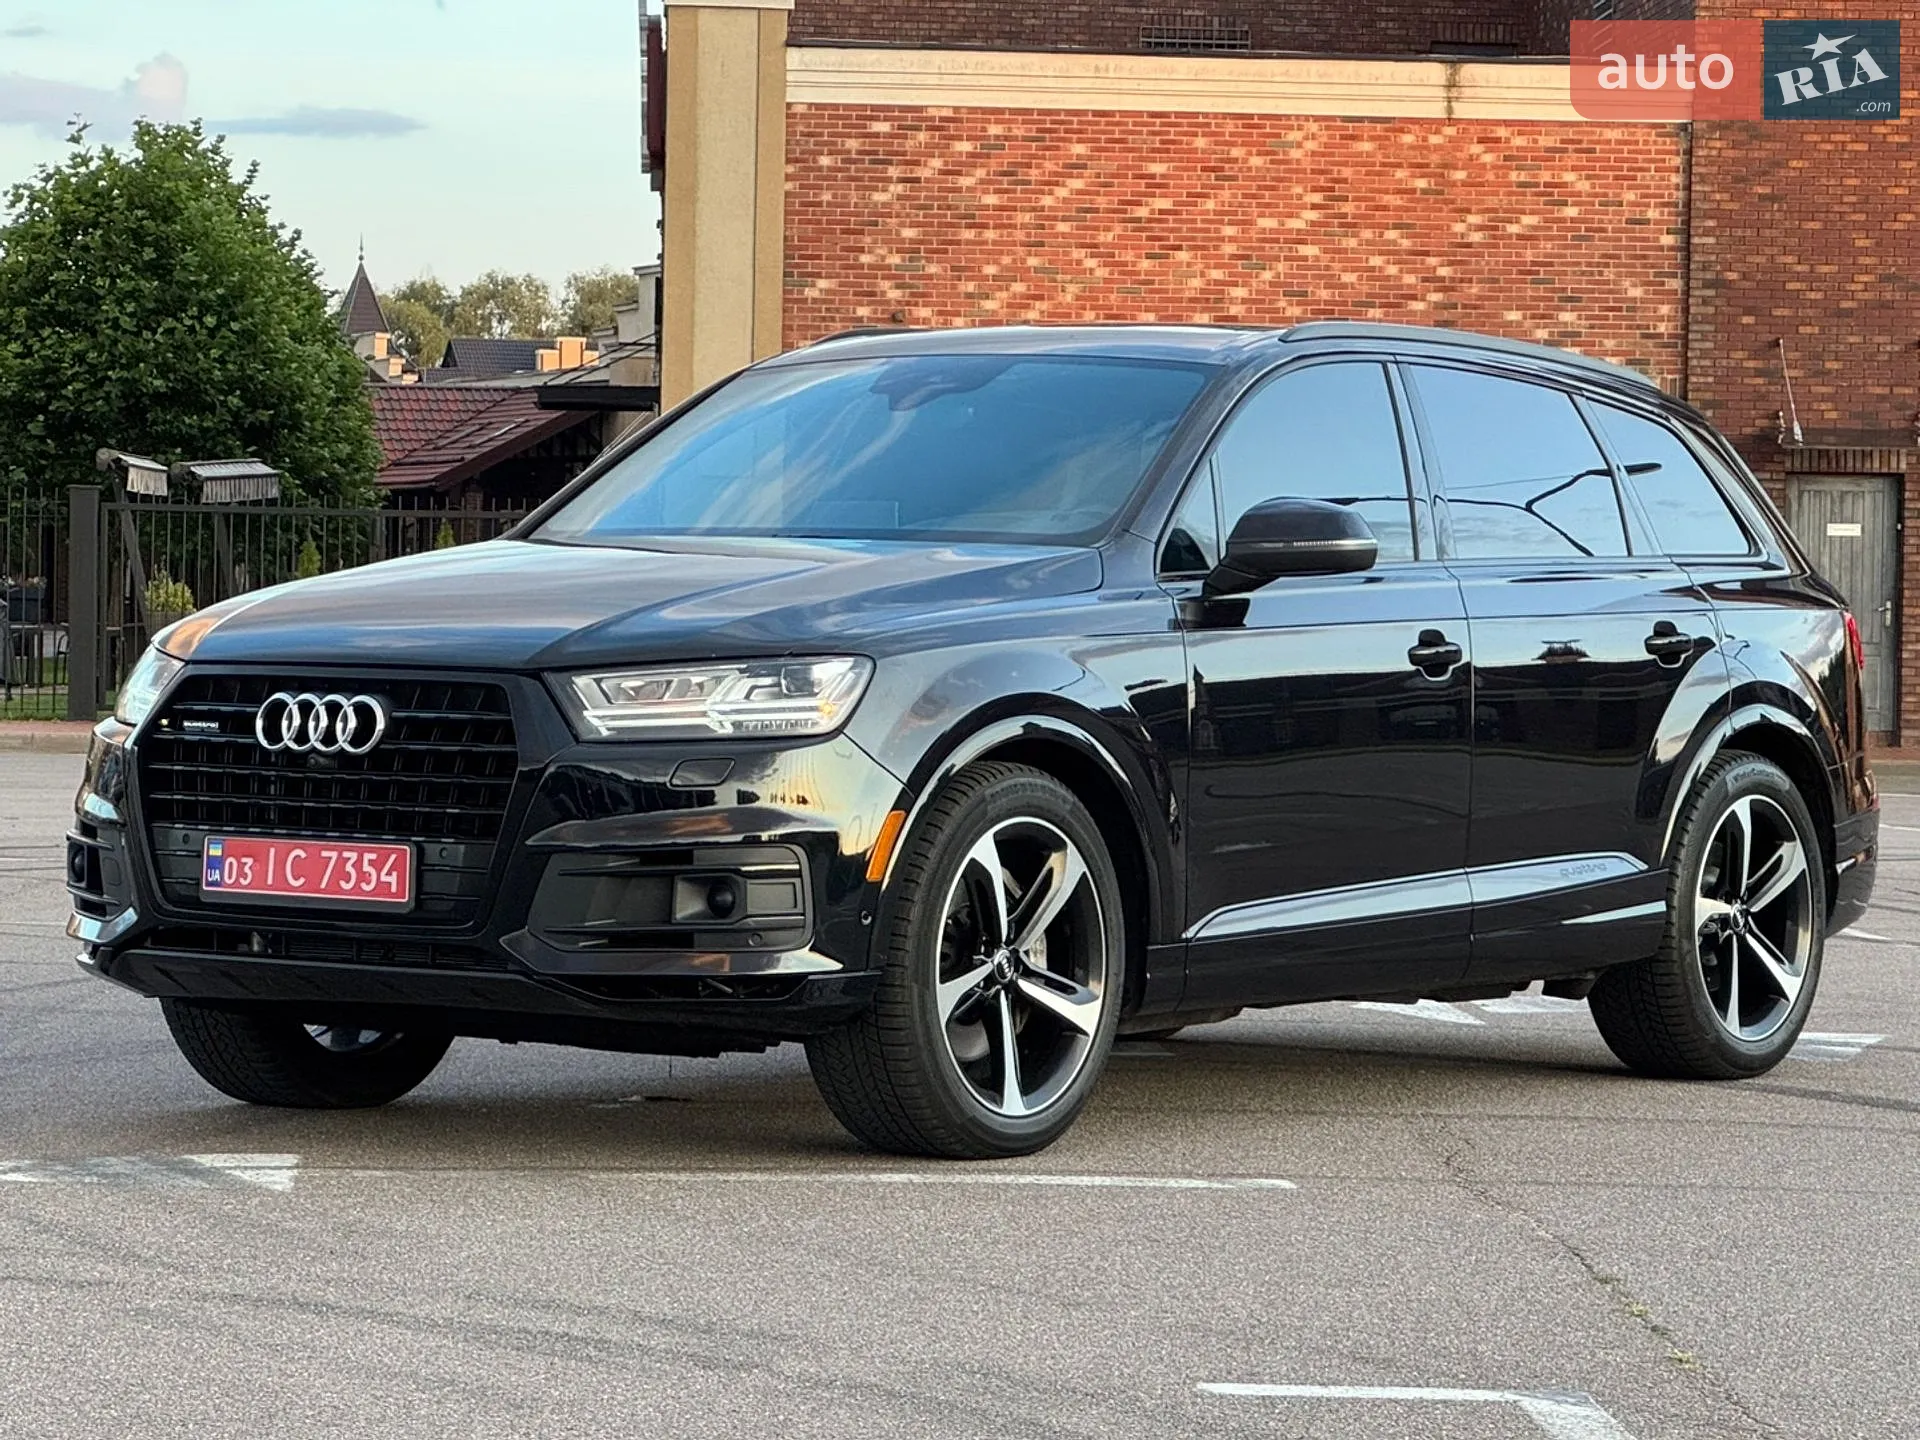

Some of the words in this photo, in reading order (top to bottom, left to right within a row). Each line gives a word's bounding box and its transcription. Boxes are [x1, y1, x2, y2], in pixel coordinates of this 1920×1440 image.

[207, 868, 220, 882] UA
[223, 857, 253, 886] 03
[319, 850, 398, 893] 7354
